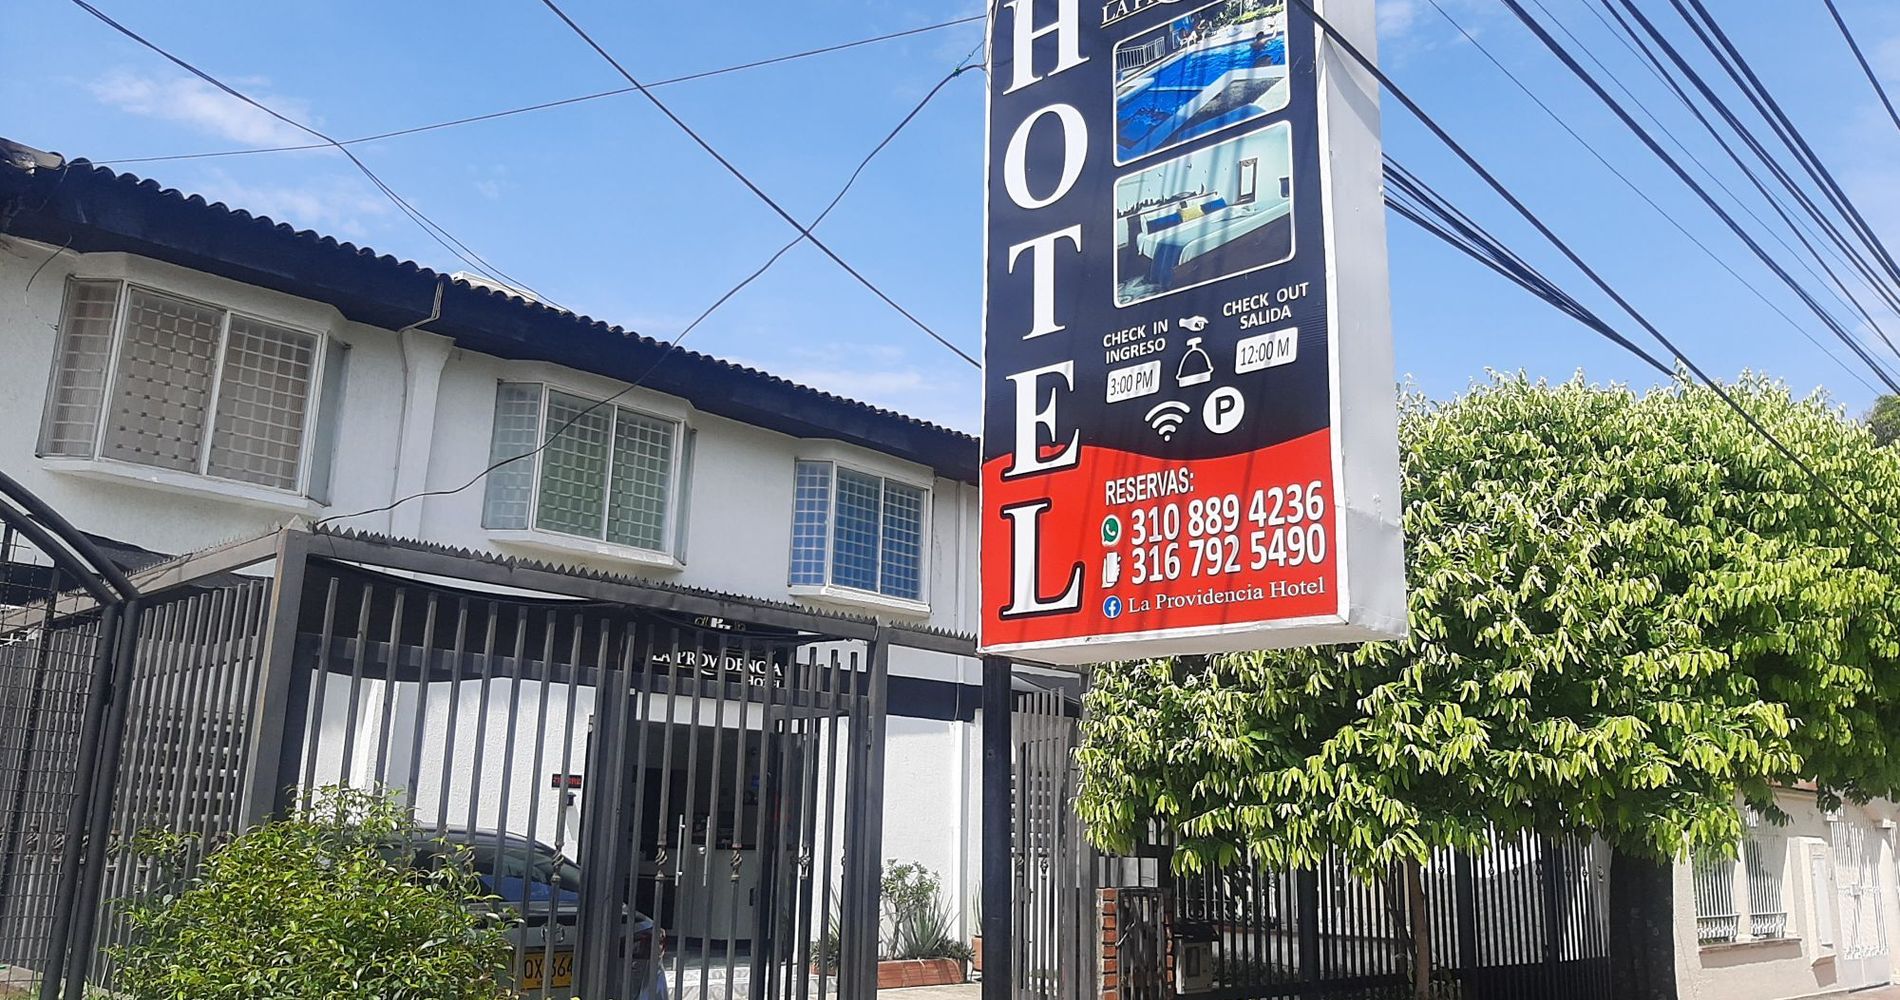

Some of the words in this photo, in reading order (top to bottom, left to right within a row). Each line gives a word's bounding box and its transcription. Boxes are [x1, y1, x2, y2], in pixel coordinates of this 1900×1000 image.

[1101, 0, 1129, 24] LA
[1002, 0, 1090, 618] HOTEL
[1223, 292, 1269, 317] CHECK
[1276, 282, 1310, 303] OUT
[1240, 305, 1292, 330] SALIDA
[1103, 325, 1146, 348] CHECK
[1153, 319, 1168, 335] IN
[1106, 338, 1166, 364] INGRESO
[1240, 341, 1273, 366] 12:00
[1277, 337, 1290, 358] M
[1110, 373, 1133, 396] 3:00
[1135, 369, 1154, 391] PM
[1215, 394, 1236, 426] P
[1105, 467, 1194, 506] RESERVAS:
[1131, 503, 1180, 546] 310
[1188, 493, 1240, 538] 889
[1248, 480, 1325, 528] 4236
[1131, 542, 1181, 586] 316
[1188, 534, 1241, 577] 792
[1250, 522, 1326, 571] 5490
[1128, 596, 1150, 614] La
[1156, 583, 1264, 611] Providencia
[1269, 576, 1325, 597] Hotel
[677, 650, 783, 676] PROVDENCA
